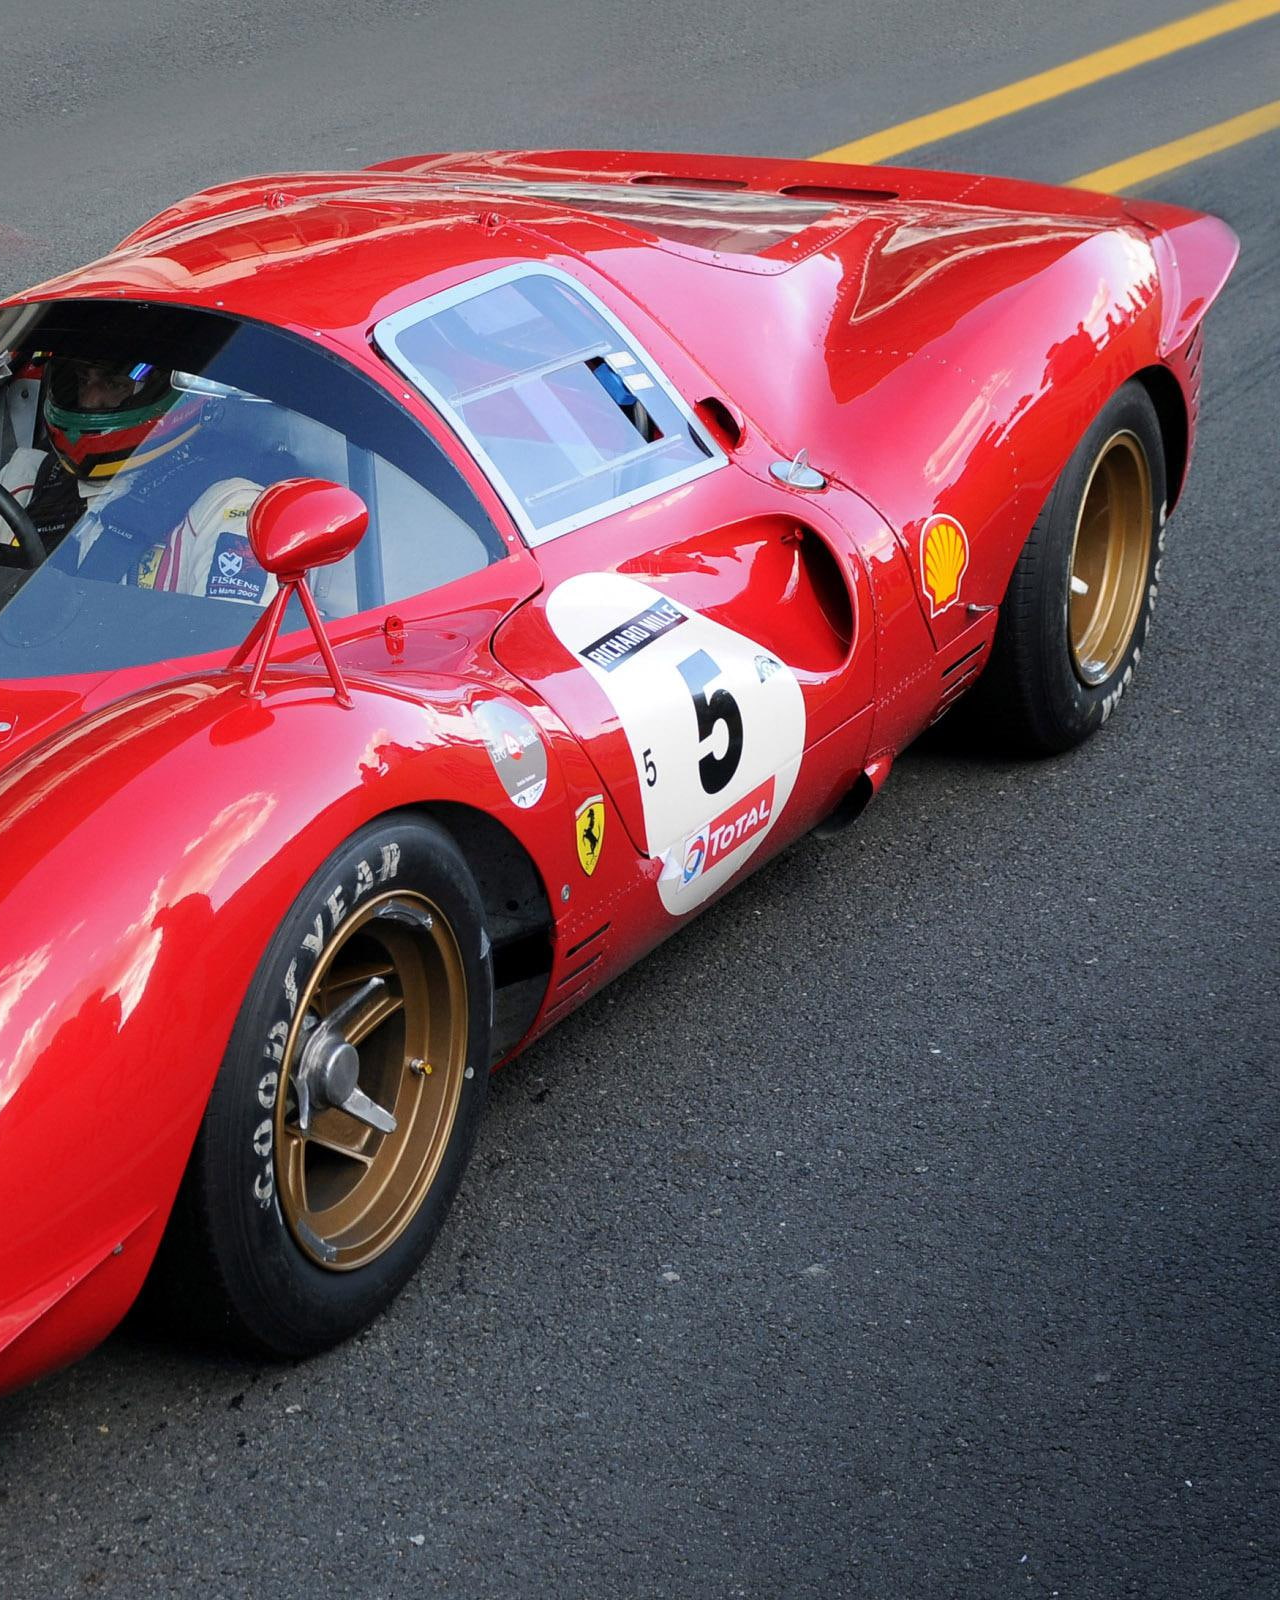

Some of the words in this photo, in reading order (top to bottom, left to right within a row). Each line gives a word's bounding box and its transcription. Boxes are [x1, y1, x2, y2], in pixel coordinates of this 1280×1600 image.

[211, 576, 260, 592] FISKENS
[587, 623, 650, 669] RICHARD
[642, 602, 683, 636] MILLE
[676, 648, 744, 795] 5
[642, 748, 658, 788] 5
[708, 799, 771, 857] TOTAL
